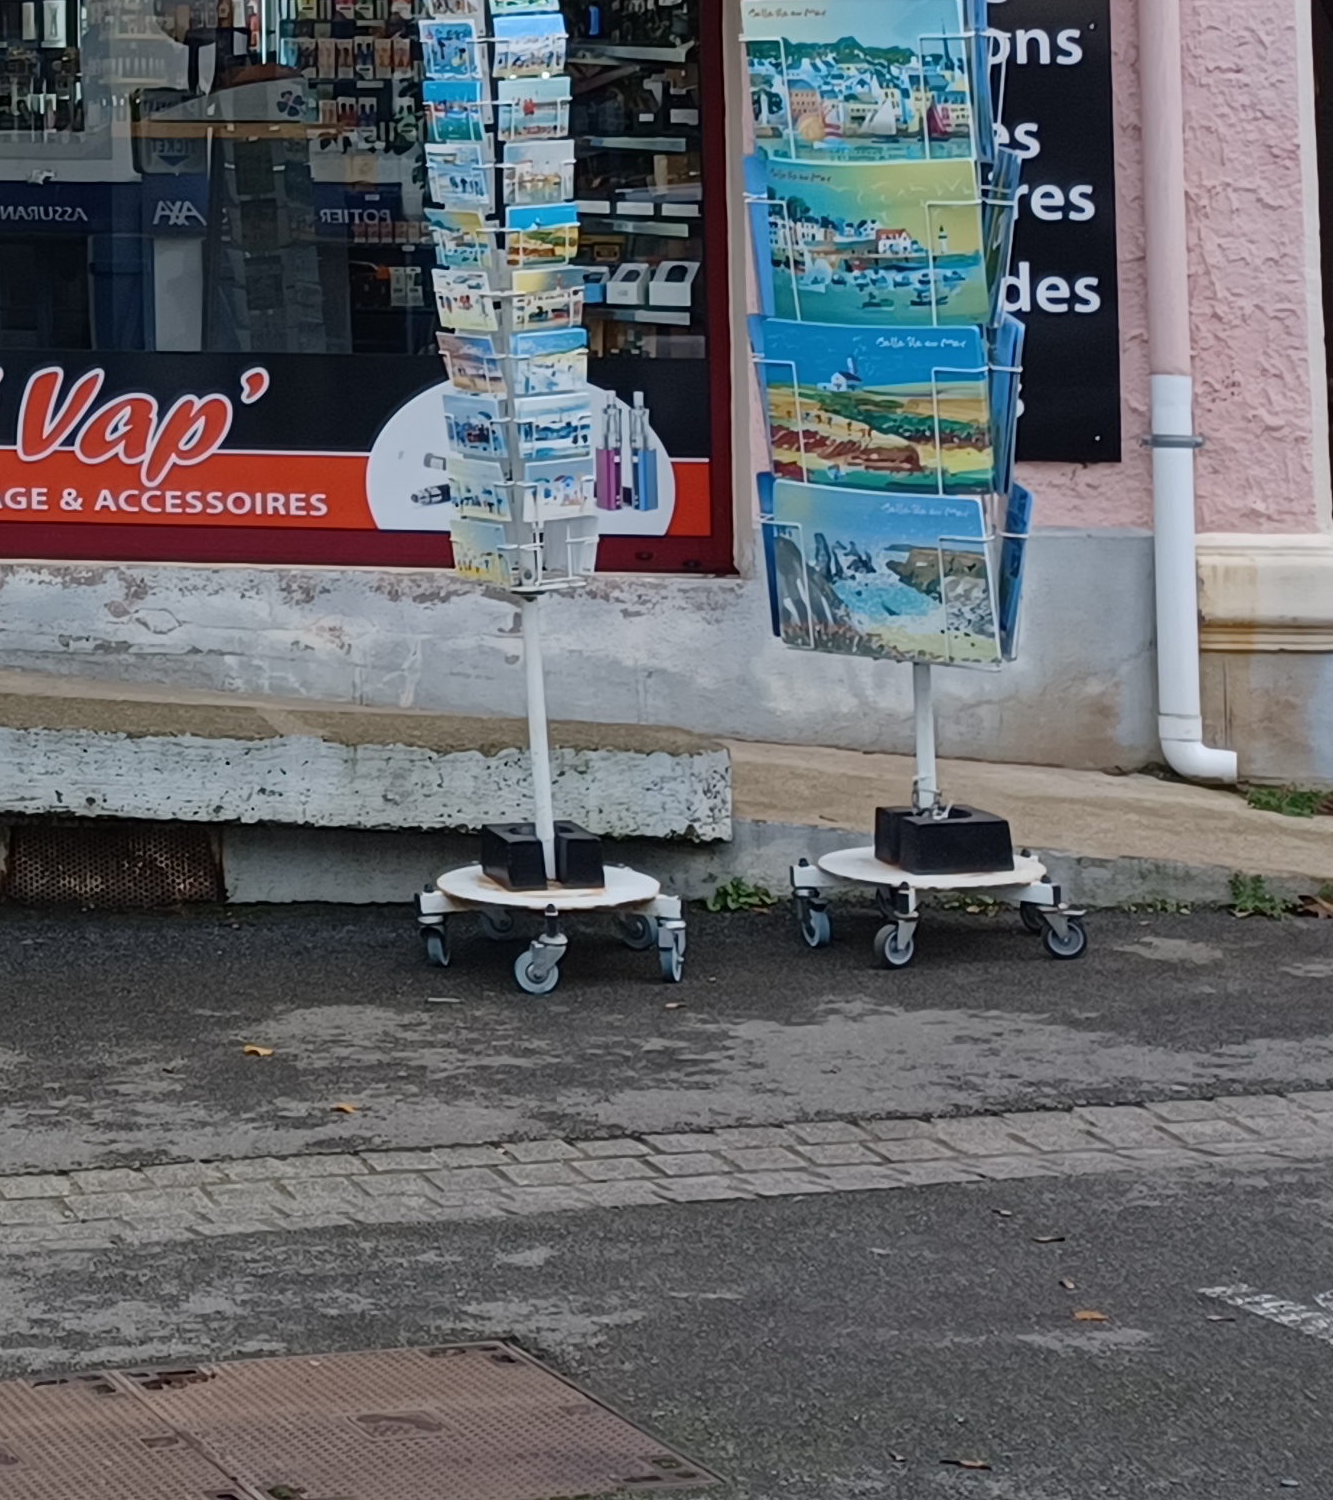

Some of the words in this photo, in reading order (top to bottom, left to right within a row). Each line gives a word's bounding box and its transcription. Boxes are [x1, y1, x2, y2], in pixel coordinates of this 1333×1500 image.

[17, 366, 269, 487] Vap'
[59, 488, 83, 511] &
[94, 489, 328, 517] ACCESSOIRES
